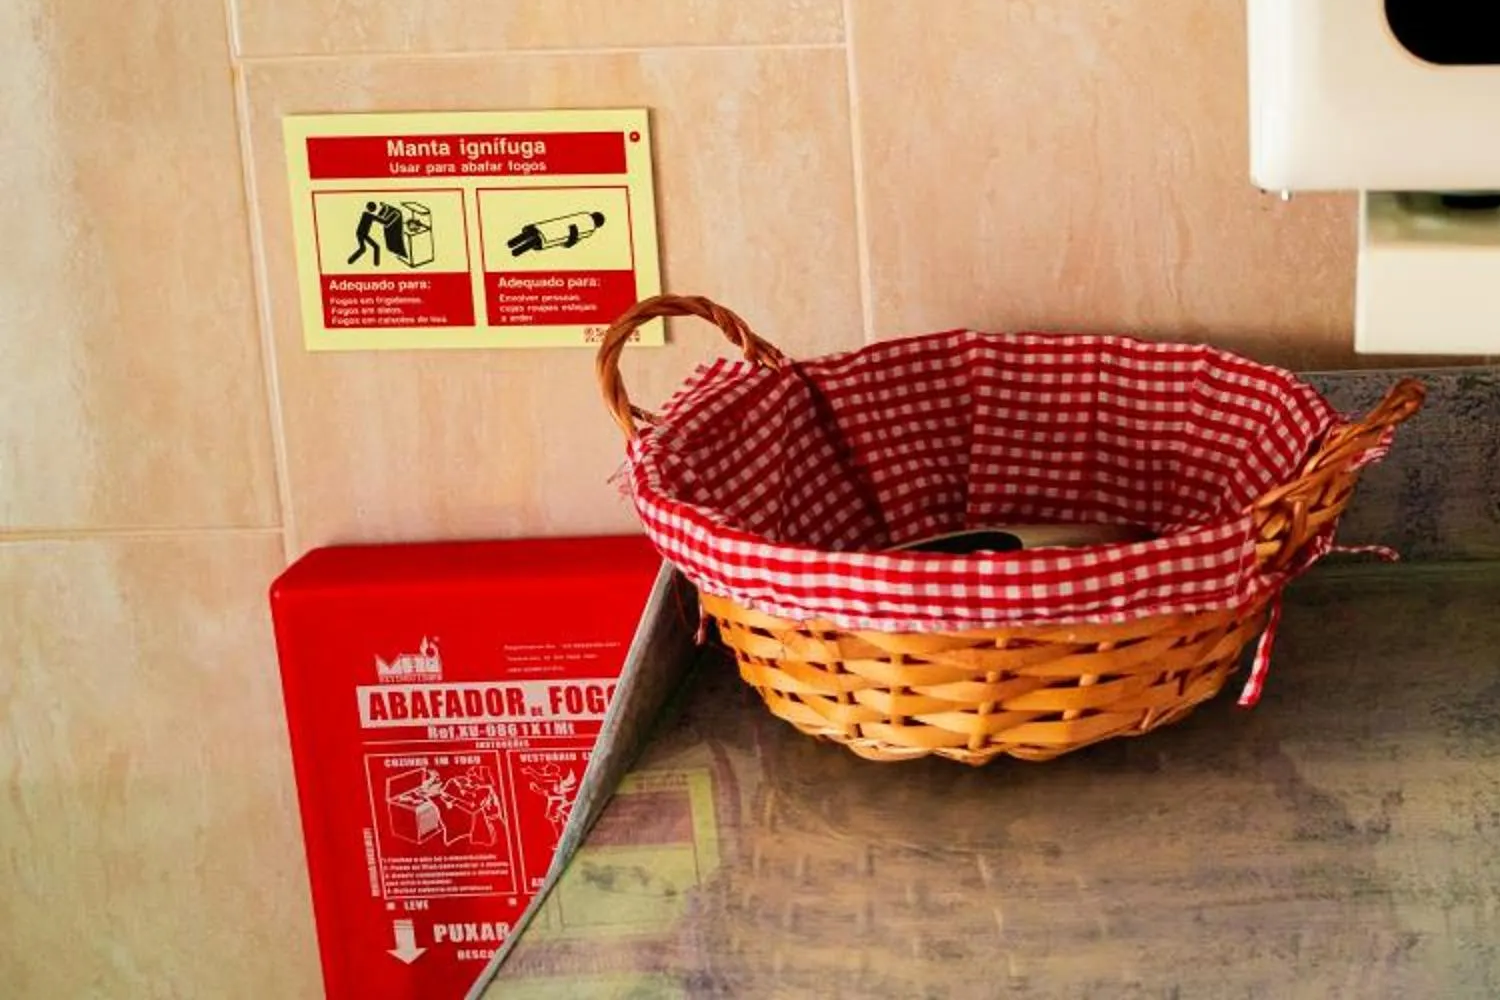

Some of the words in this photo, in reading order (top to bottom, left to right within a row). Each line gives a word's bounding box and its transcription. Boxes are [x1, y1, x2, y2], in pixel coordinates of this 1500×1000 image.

[386, 138, 450, 157] Manta
[458, 136, 547, 160] ignífuga
[389, 161, 421, 174] Usar
[425, 162, 456, 176] para
[461, 160, 503, 174] abafar
[507, 159, 547, 176] fogos
[329, 279, 395, 293] Adequado
[398, 279, 432, 293] para:
[498, 276, 565, 290] Adequado
[368, 687, 526, 721] ABAFADOR
[432, 921, 510, 944] PUXAR
